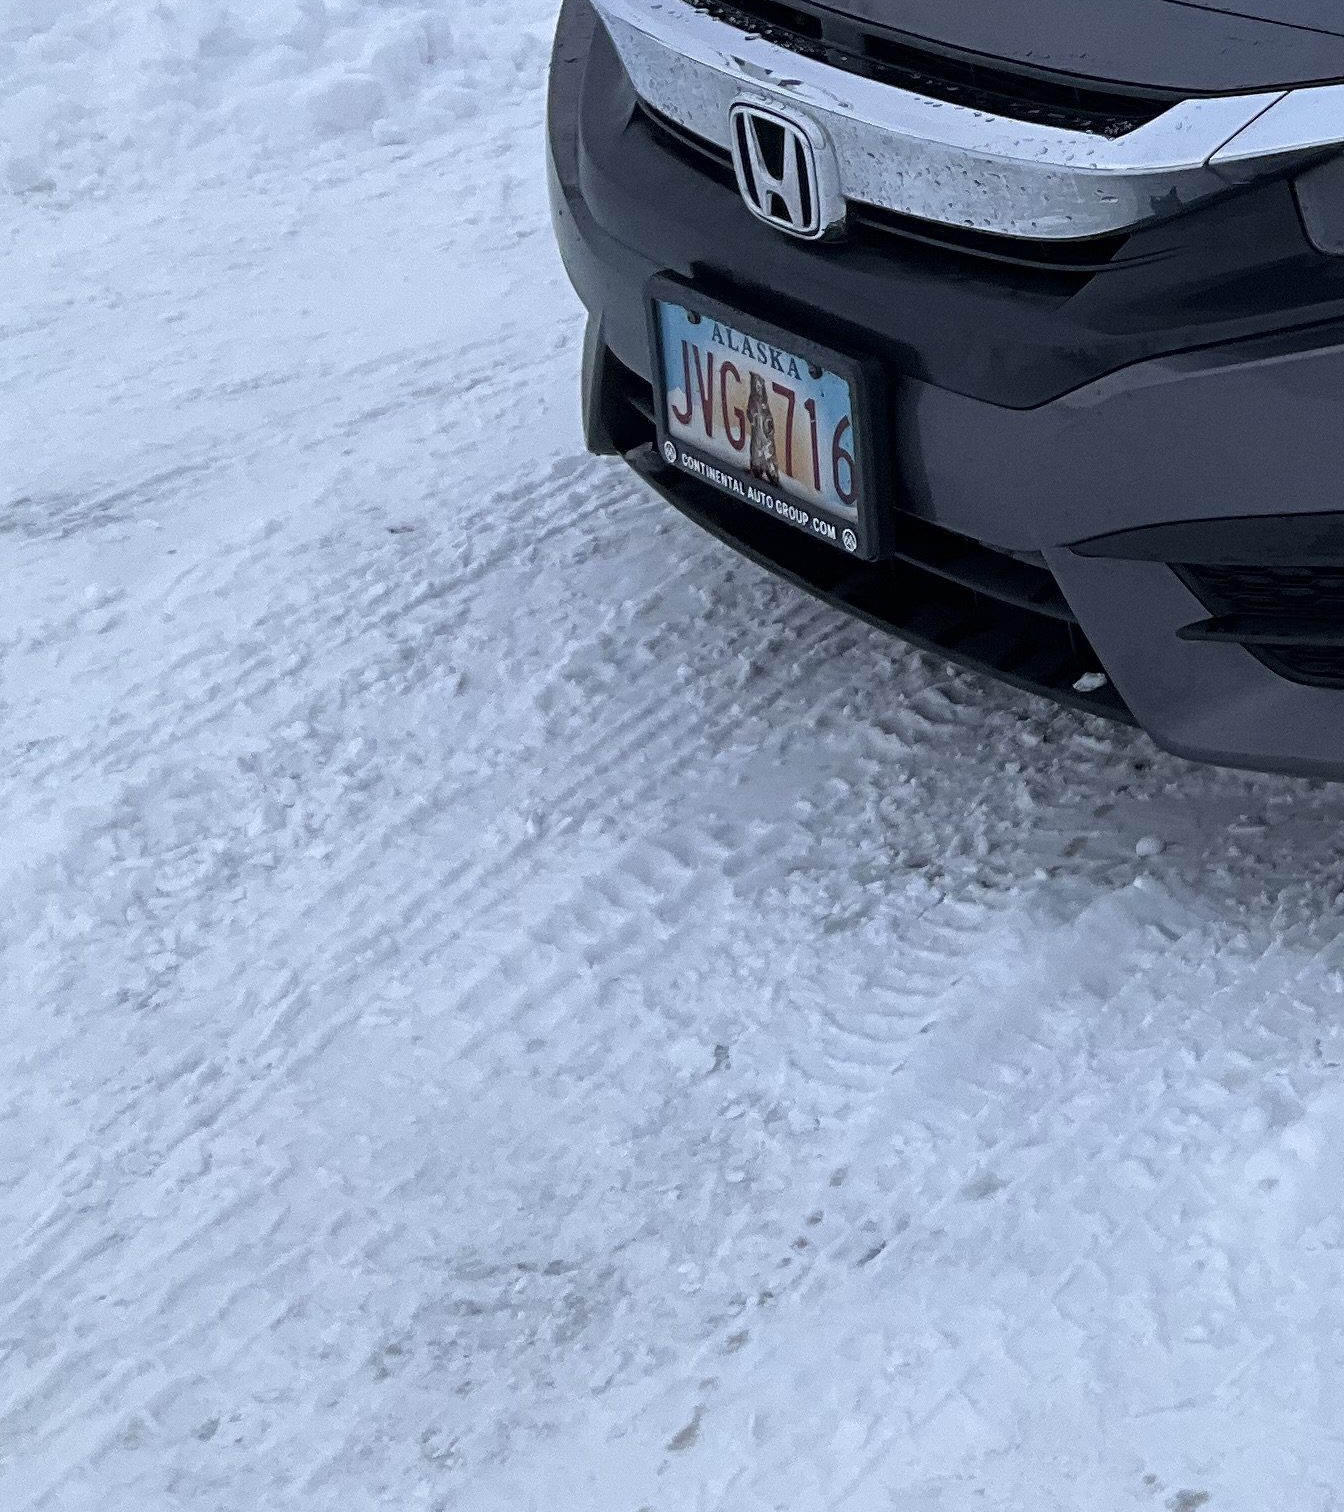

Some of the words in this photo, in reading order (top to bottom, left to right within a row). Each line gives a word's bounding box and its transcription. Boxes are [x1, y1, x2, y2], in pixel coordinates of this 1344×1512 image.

[711, 323, 803, 381] ALASKA
[672, 340, 746, 451] JVG
[772, 381, 858, 505] 716
[681, 453, 746, 497] CONTINENTAL
[747, 488, 774, 509] AUTO
[775, 499, 809, 525] GROUP
